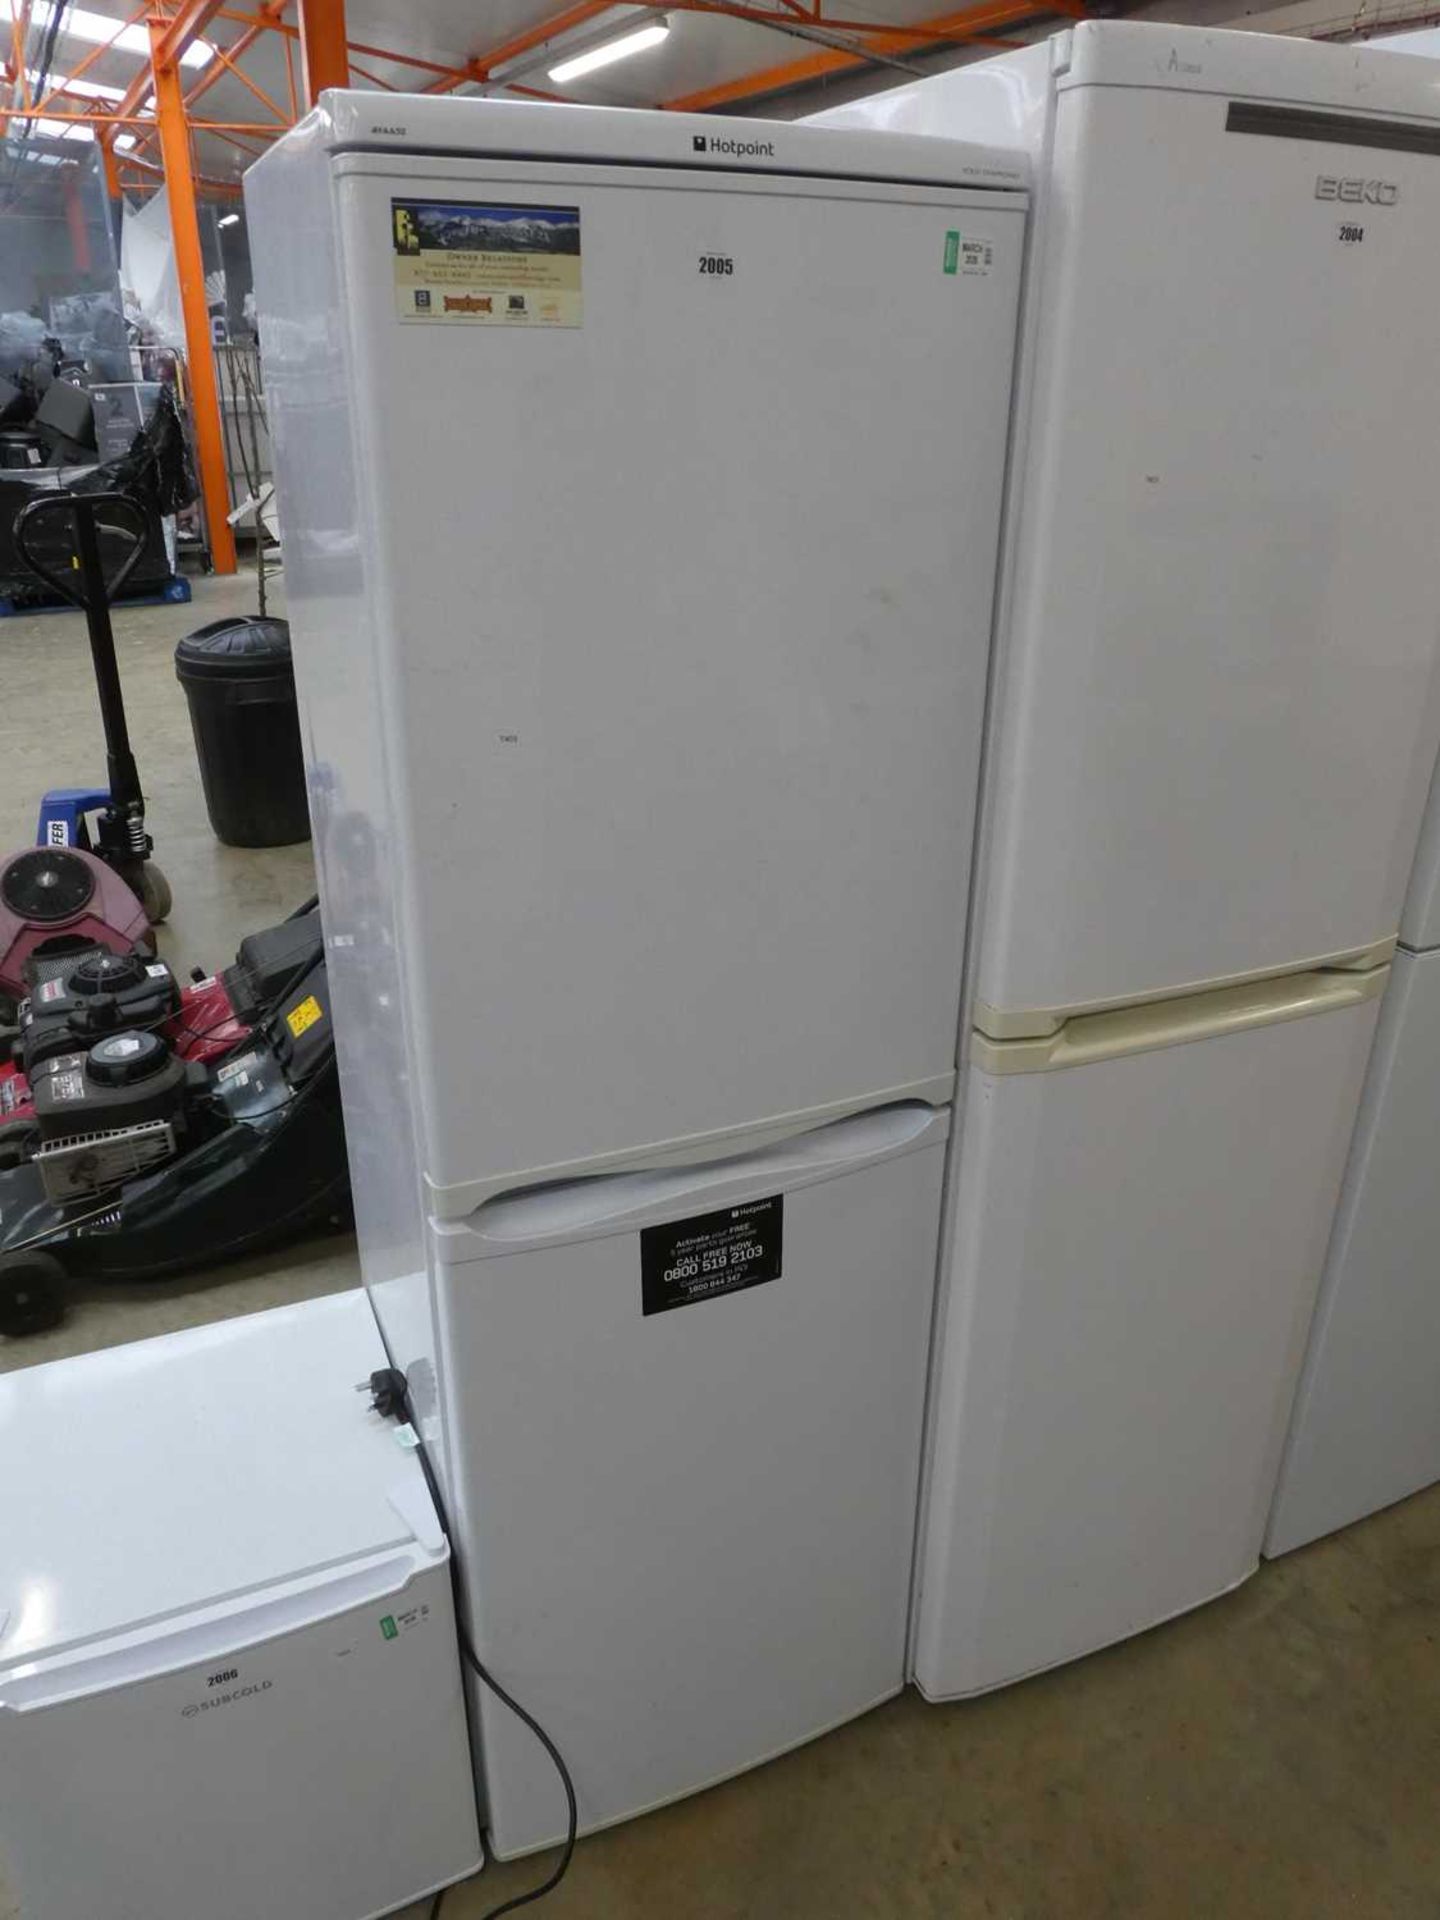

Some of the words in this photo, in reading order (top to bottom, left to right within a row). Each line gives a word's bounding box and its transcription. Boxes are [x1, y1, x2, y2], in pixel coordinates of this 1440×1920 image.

[711, 138, 775, 158] Hotpoint
[1315, 175, 1398, 206] BEKO
[1339, 226, 1363, 242] 2004
[699, 257, 734, 275] 2005
[740, 1202, 772, 1216] Hotpoint
[676, 1235, 710, 1248] Activate
[729, 1222, 751, 1234] FREE
[663, 1263, 698, 1282] 0800
[702, 1256, 727, 1272] 519
[731, 1245, 763, 1264] 2103
[676, 1254, 701, 1267] CALL
[703, 1246, 728, 1260] FREE
[729, 1240, 752, 1253] NOW
[207, 1669, 239, 1688] 2006
[200, 1680, 273, 1711] SUBCOLD
